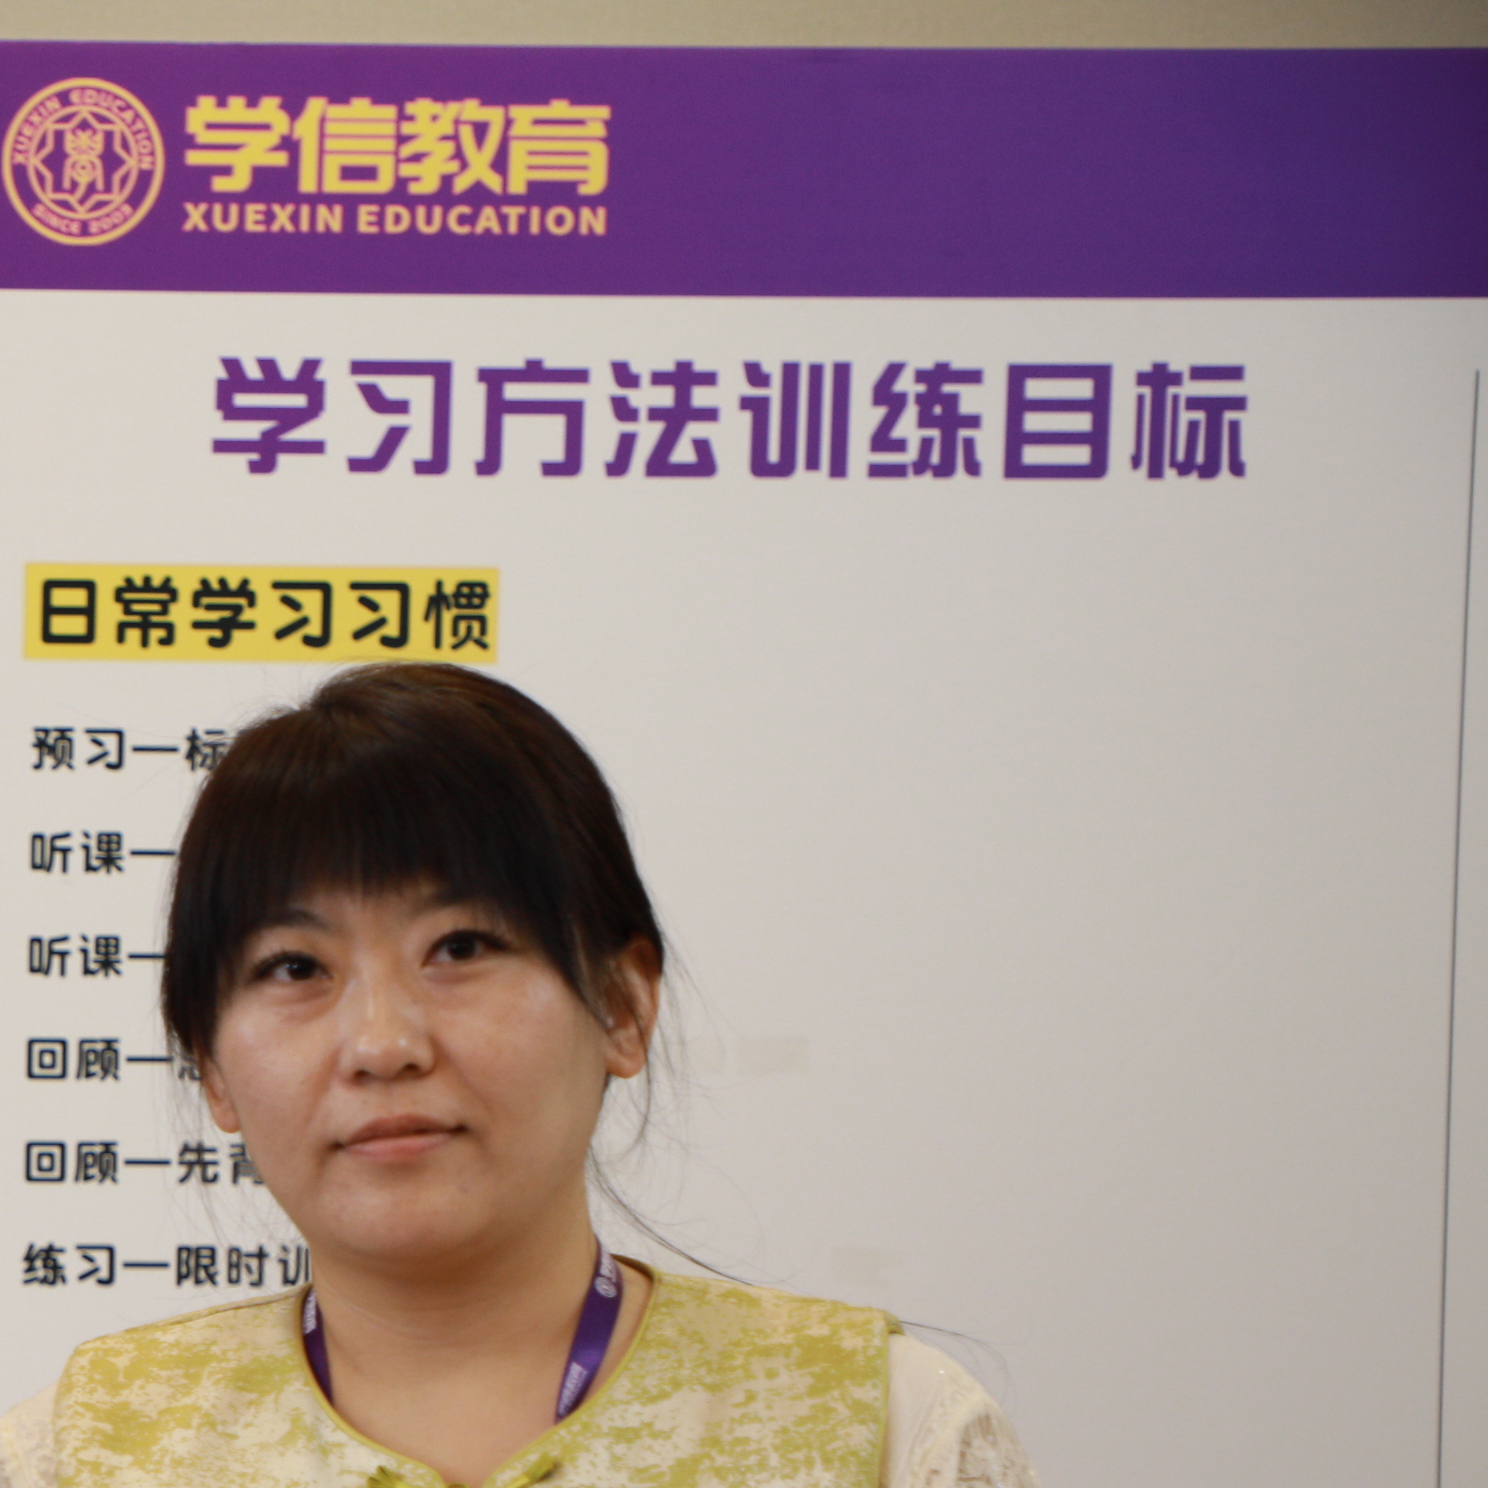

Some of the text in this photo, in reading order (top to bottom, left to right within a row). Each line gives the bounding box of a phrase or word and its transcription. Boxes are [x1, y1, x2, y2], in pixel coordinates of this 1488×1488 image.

[184, 95, 612, 195] 学信教育
[182, 202, 606, 236] XUEXIN EDUCATION
[212, 356, 1248, 481] 学习方法训练目标
[40, 575, 492, 651] 日常学习习惯
